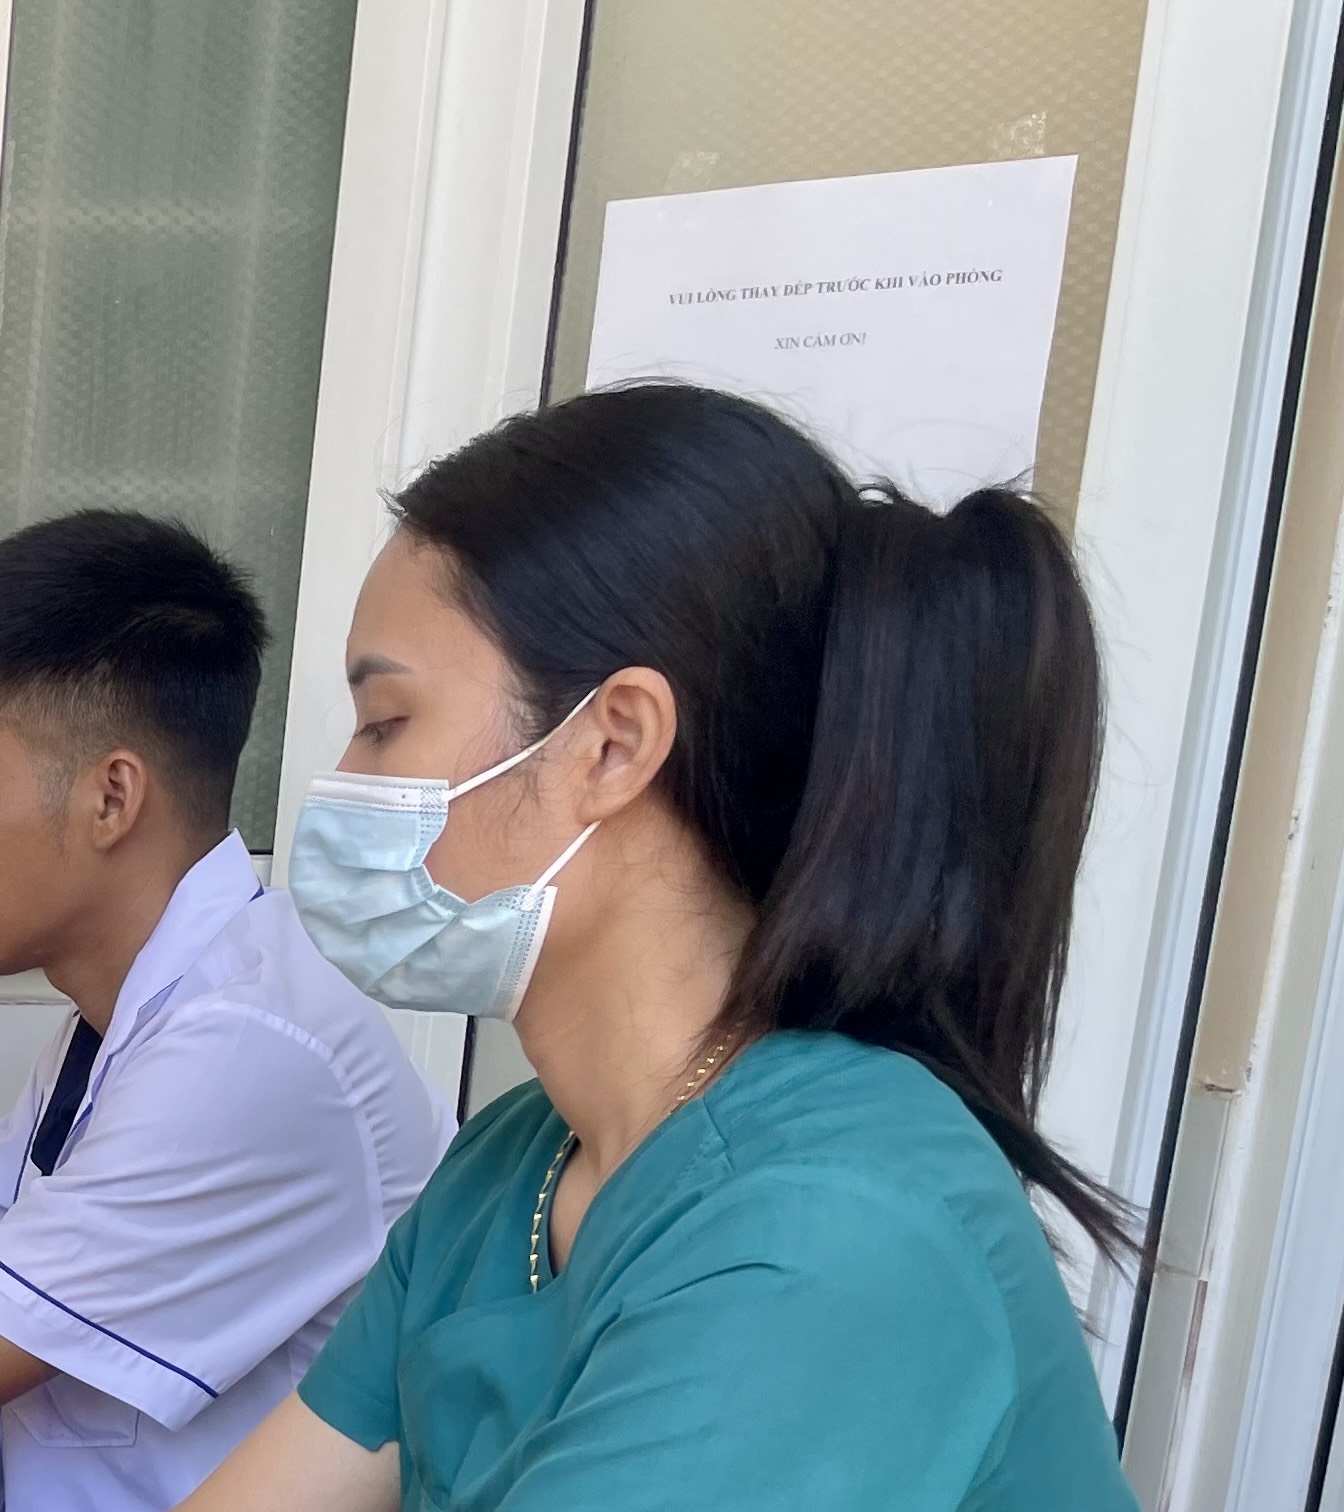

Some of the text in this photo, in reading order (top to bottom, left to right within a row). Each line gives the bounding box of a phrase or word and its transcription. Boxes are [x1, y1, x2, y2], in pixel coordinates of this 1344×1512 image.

[669, 293, 693, 305] VUI
[740, 286, 780, 300] THAY
[874, 276, 903, 290] KHI
[774, 336, 800, 350] XIN
